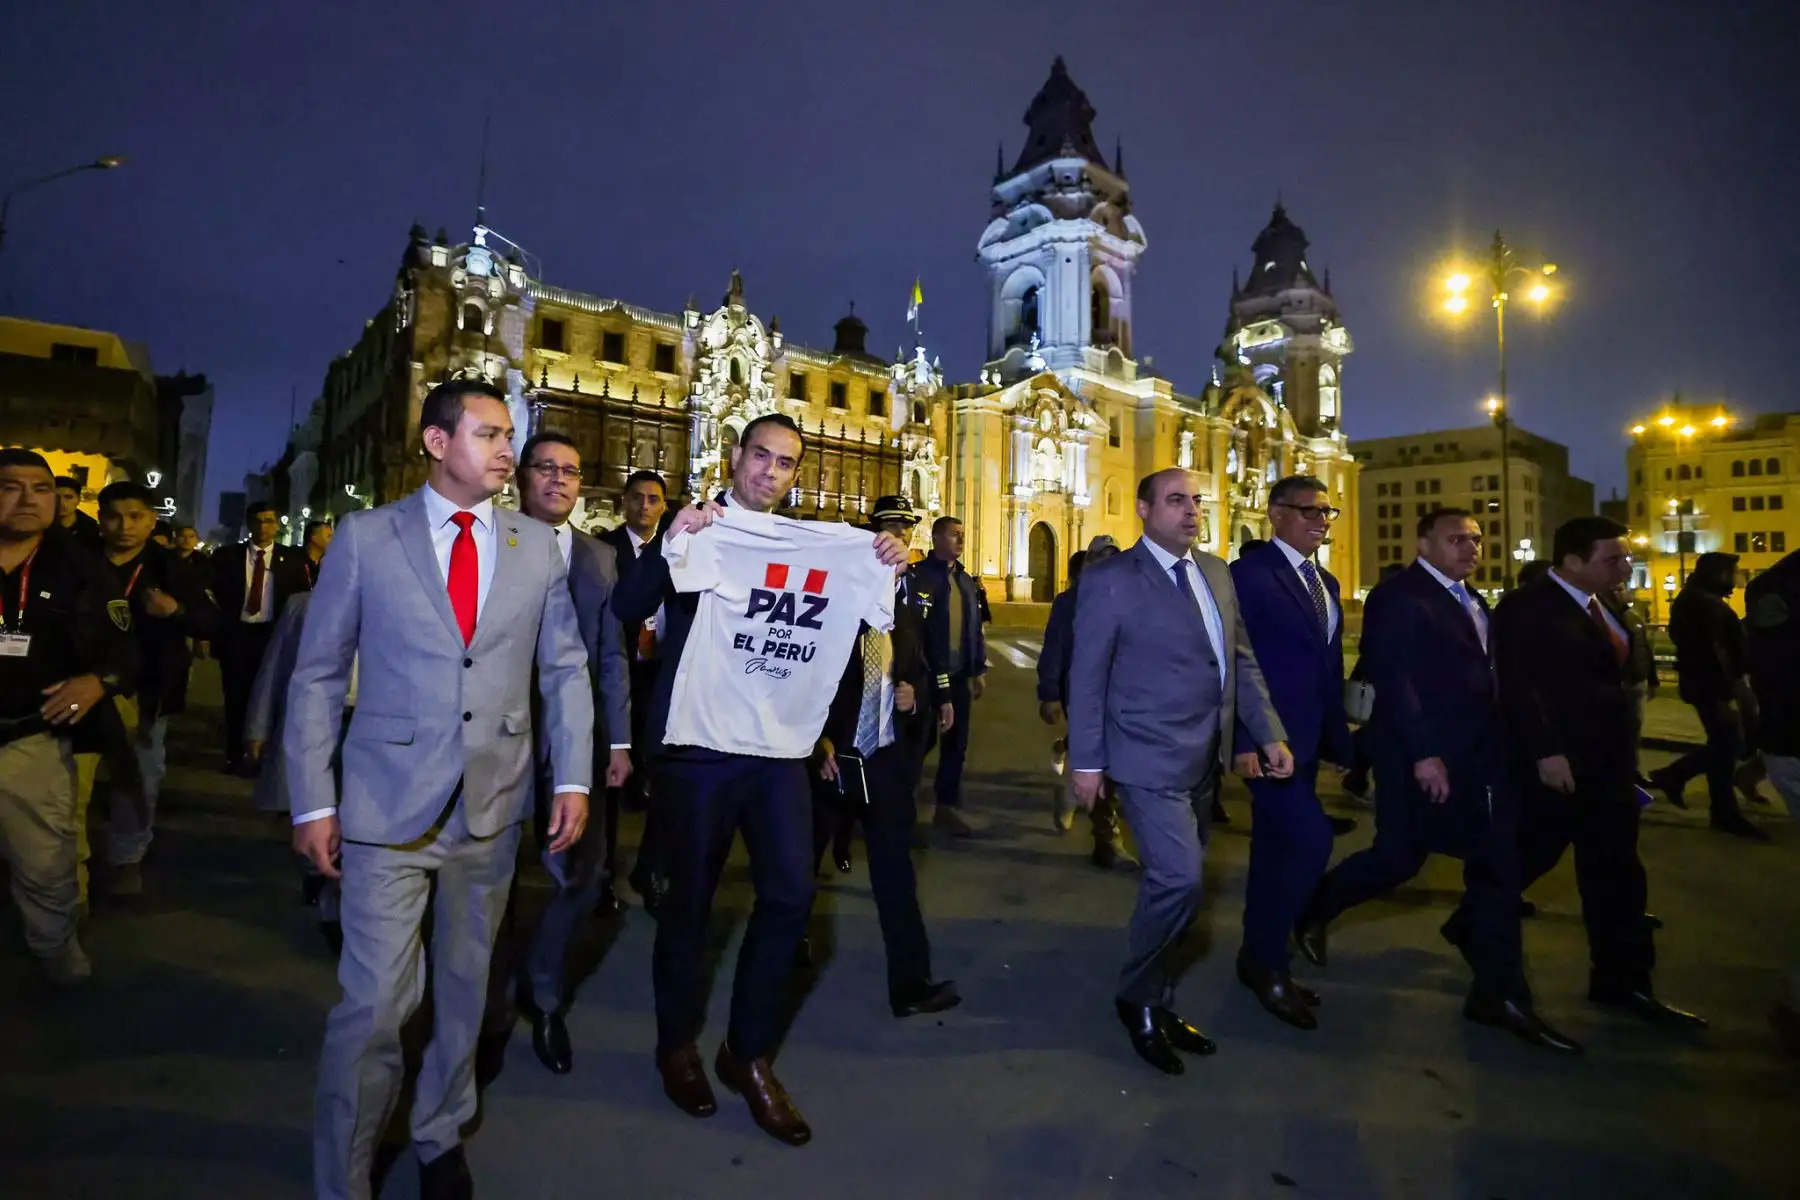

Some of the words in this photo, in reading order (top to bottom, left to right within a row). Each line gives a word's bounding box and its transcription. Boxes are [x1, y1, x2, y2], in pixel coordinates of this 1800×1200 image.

[744, 588, 830, 630] PAZ
[733, 633, 755, 653] EL
[761, 640, 816, 663] PERÚ
[768, 627, 792, 639] POR
